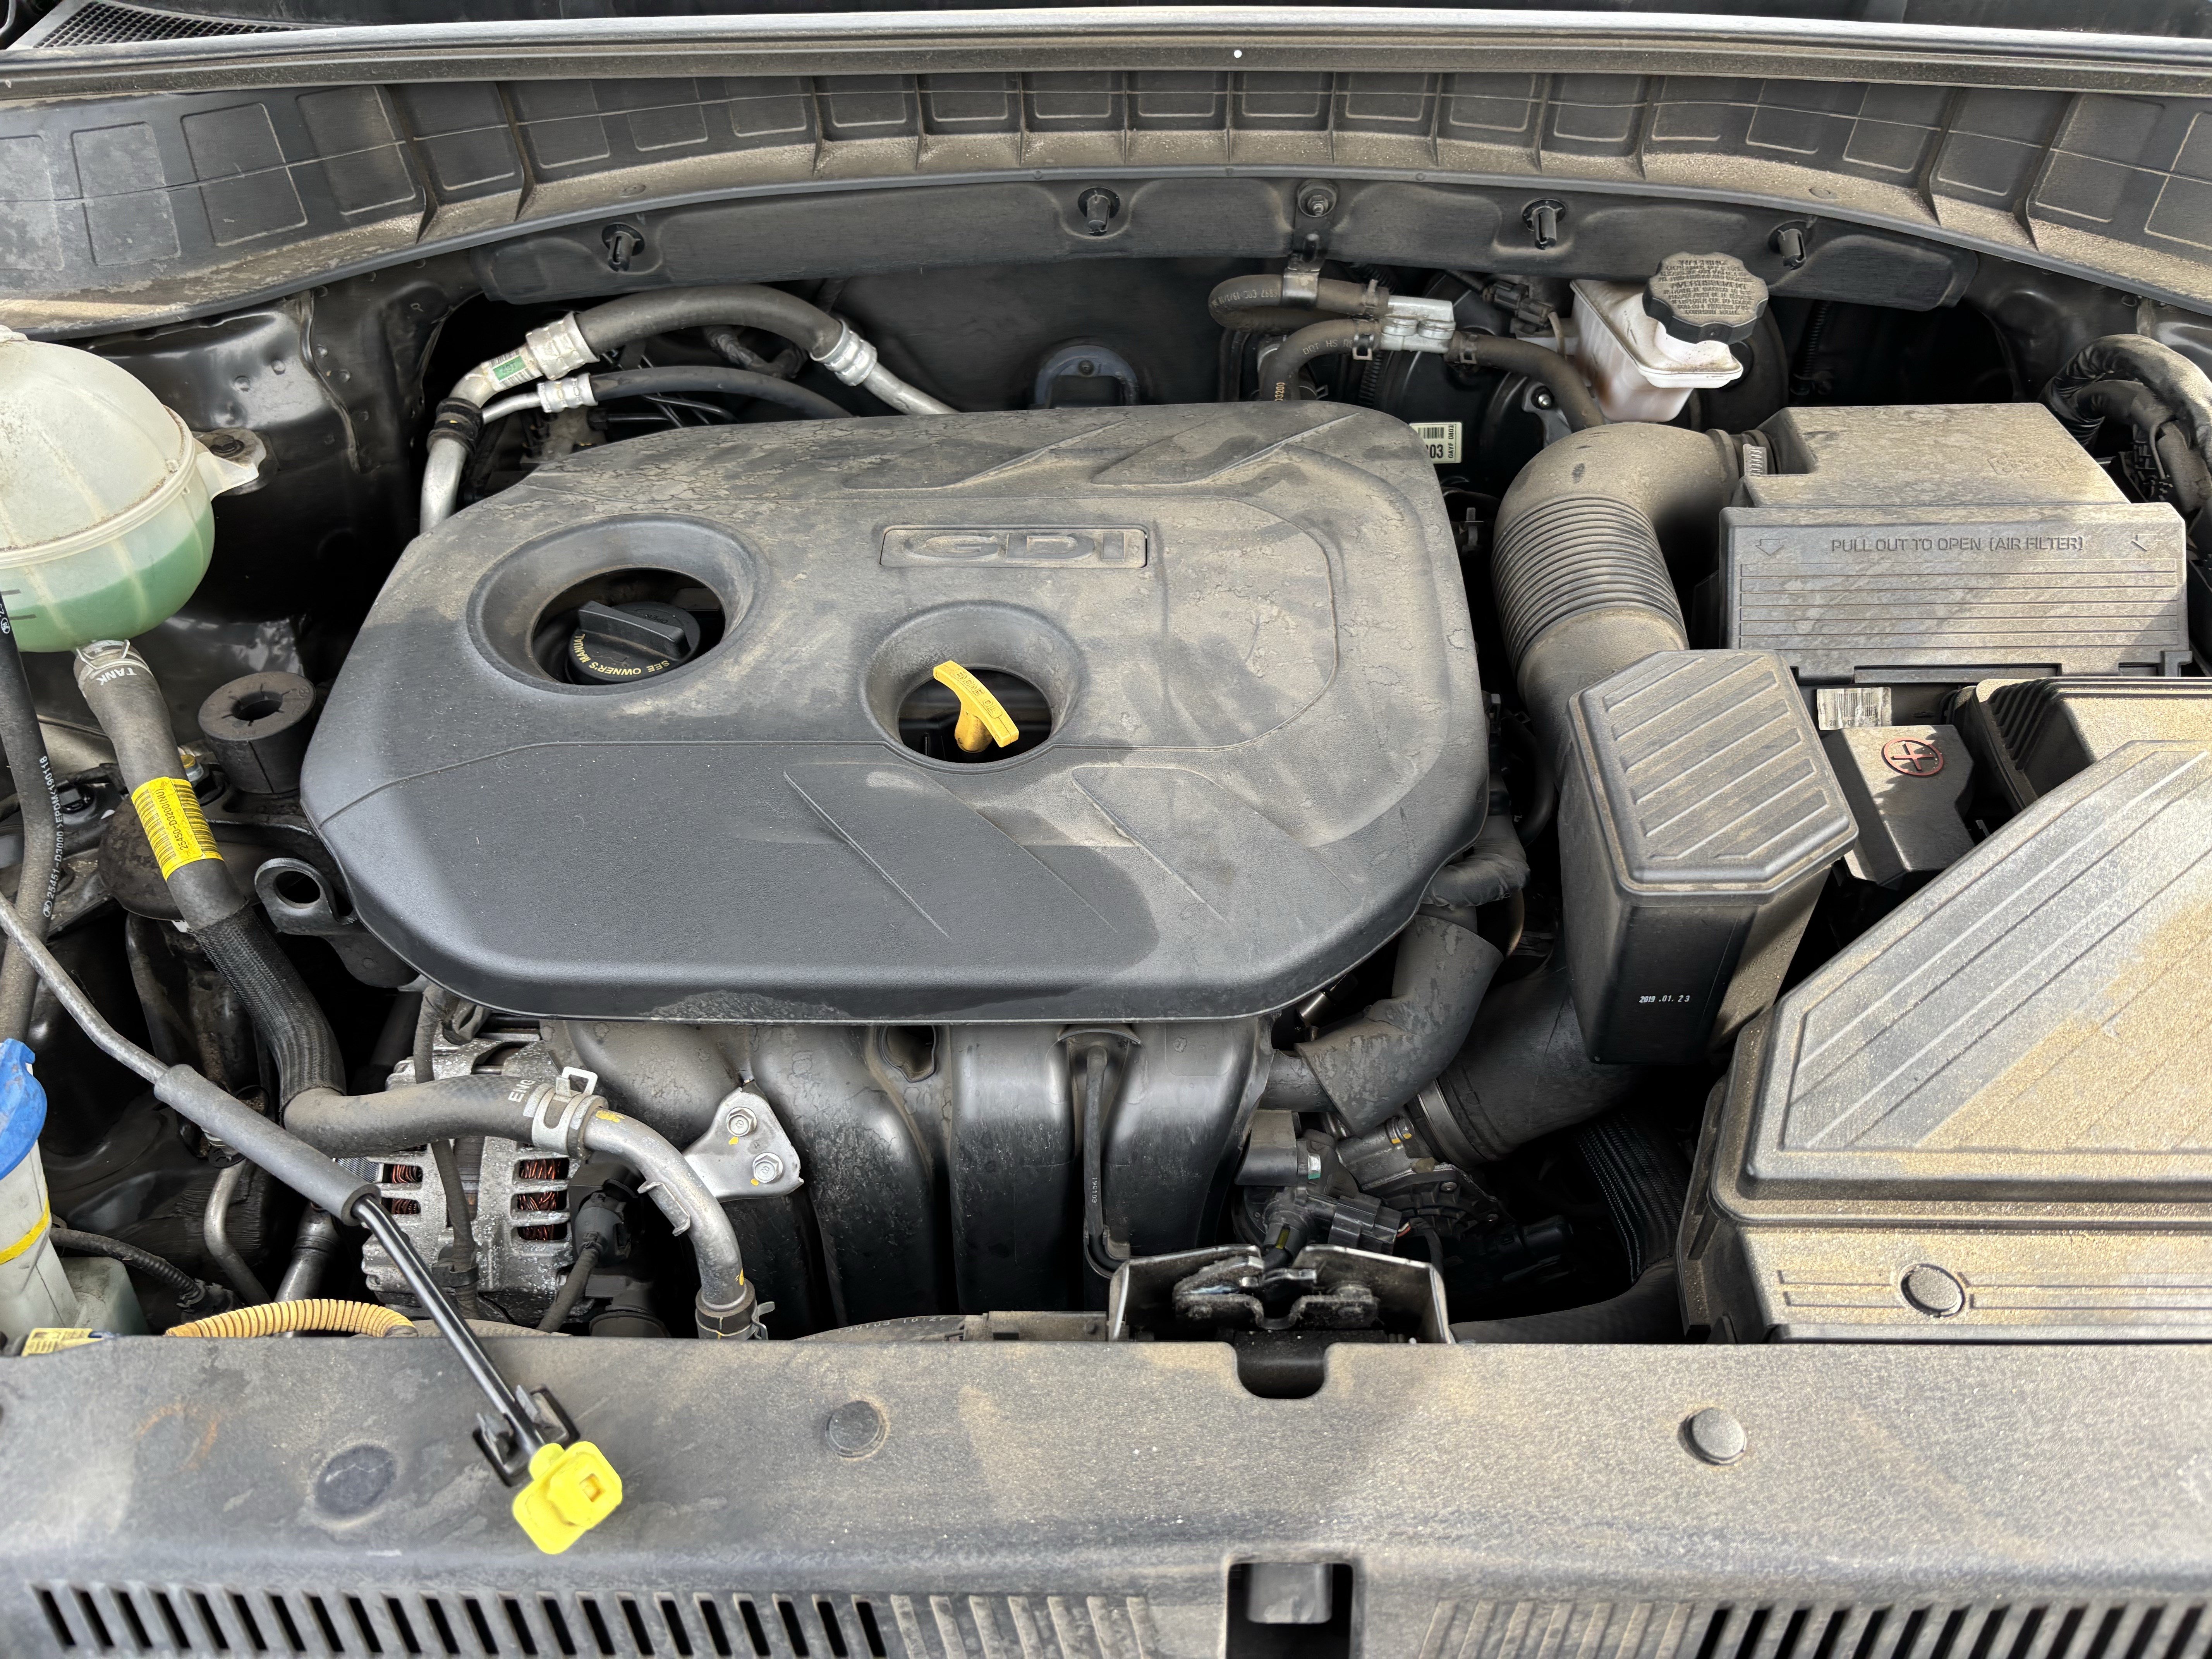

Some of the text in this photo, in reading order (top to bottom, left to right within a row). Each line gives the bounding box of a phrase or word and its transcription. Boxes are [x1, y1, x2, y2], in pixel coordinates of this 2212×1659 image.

[1426, 444, 1444, 459] 03
[903, 532, 1125, 562] GDI
[1832, 539, 1872, 552] PULL
[1876, 538, 1907, 551] OUT
[1912, 538, 1932, 551] TO
[1938, 537, 1981, 551] OPEN
[574, 634, 670, 675] SEE OWNER'S MANUAL
[96, 667, 137, 686] TANK
[954, 671, 998, 715] ENGINE OIL
[155, 788, 188, 850] 25450-D3200(NU)
[508, 1079, 536, 1103] ENG
